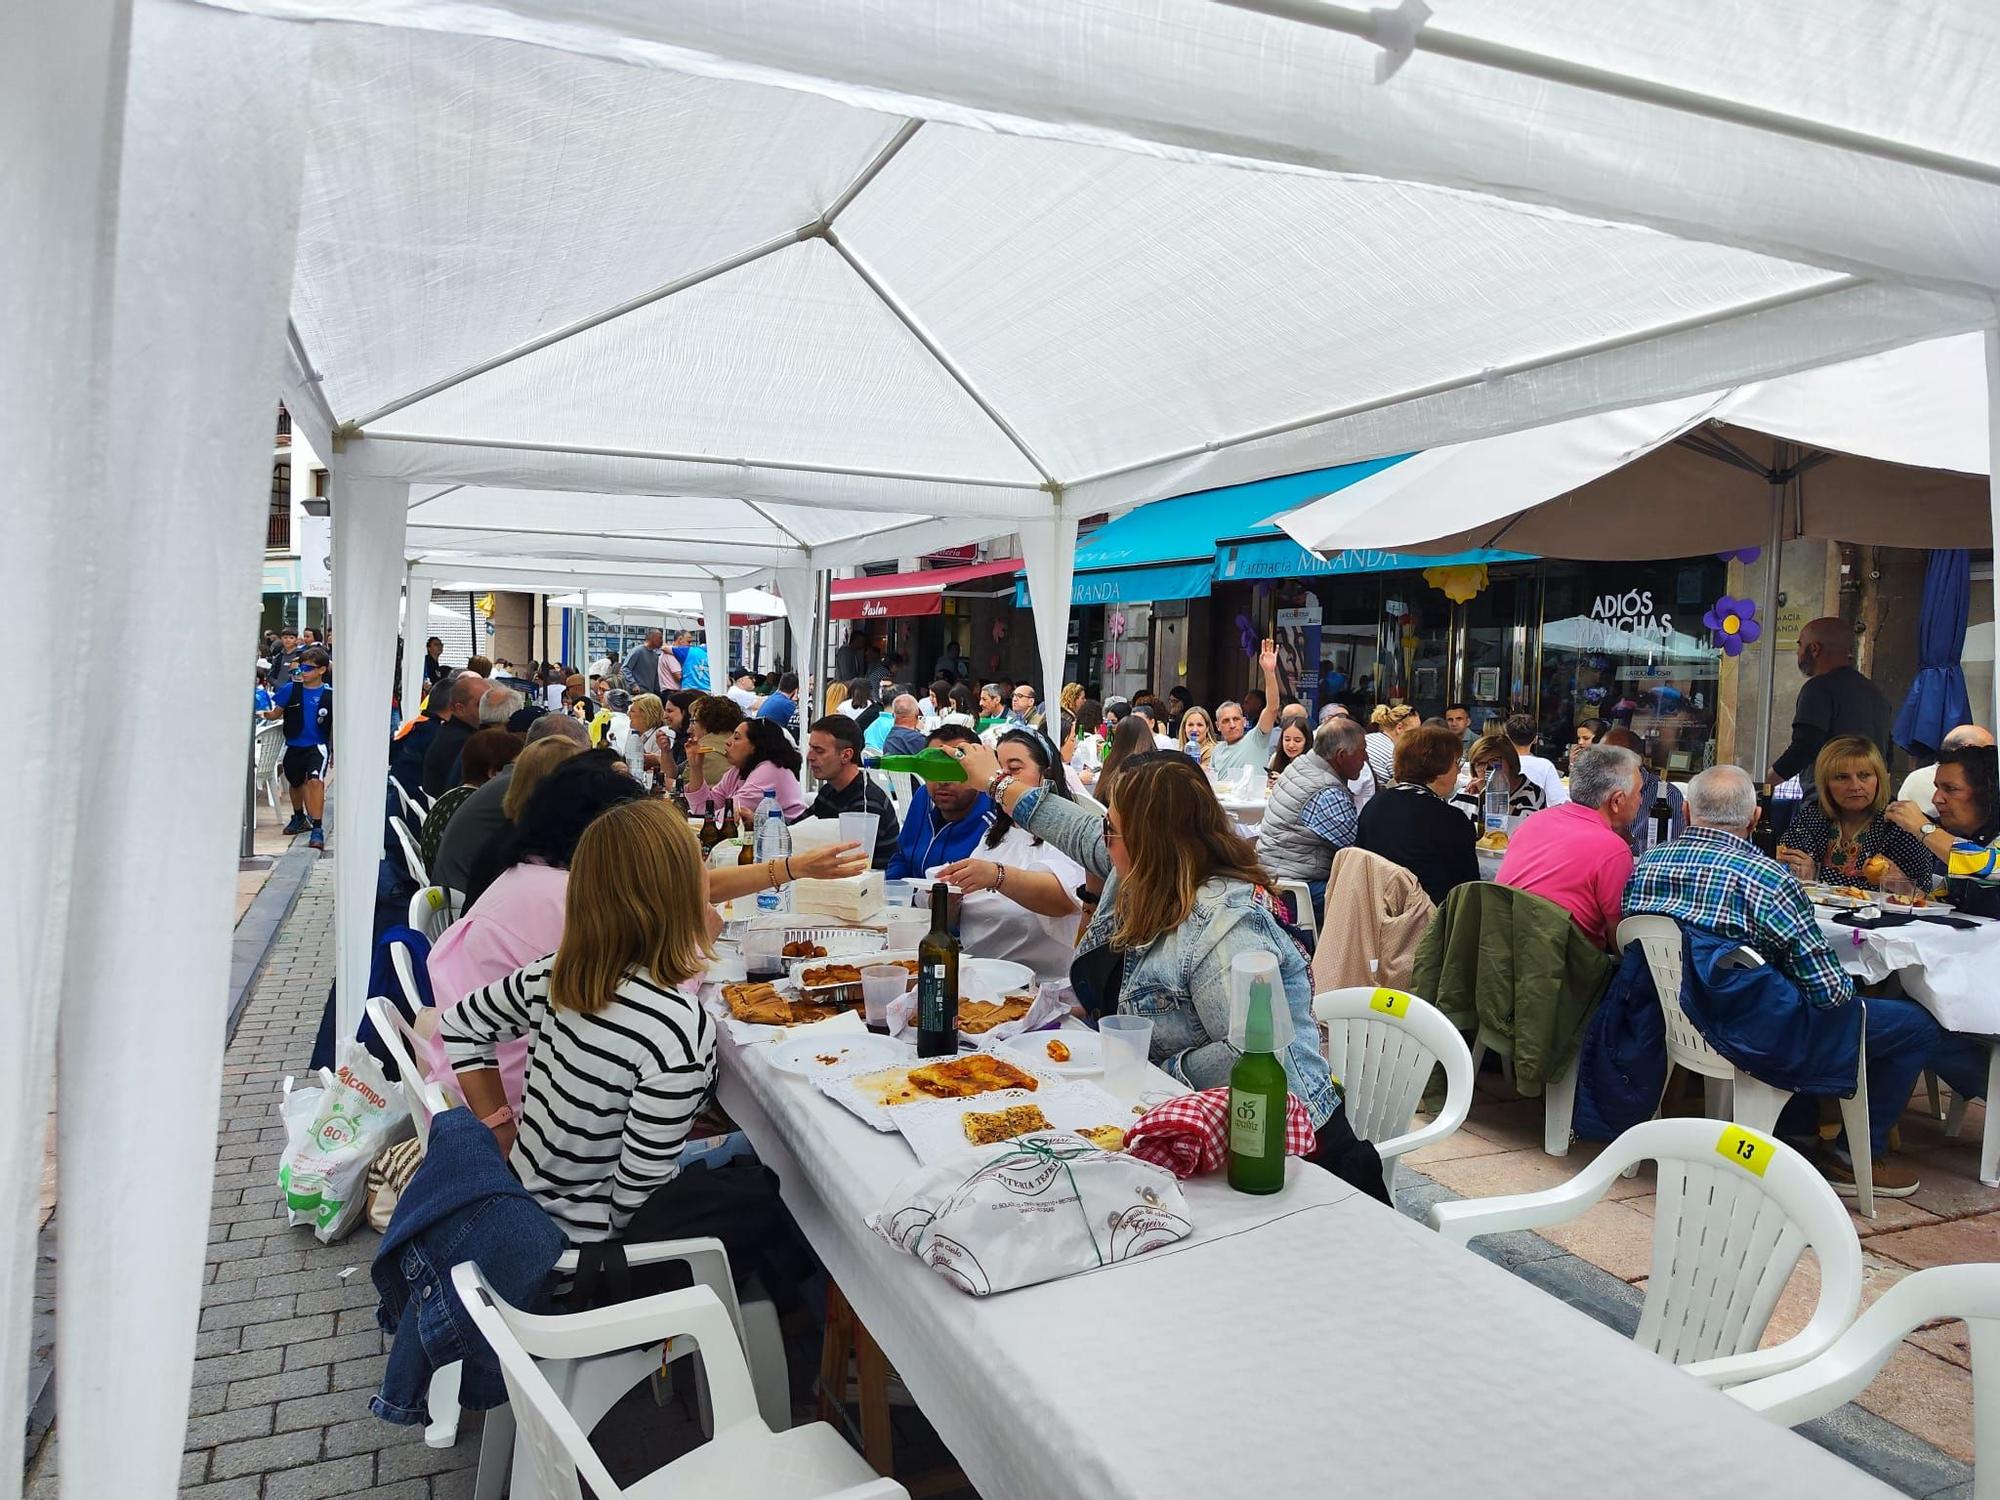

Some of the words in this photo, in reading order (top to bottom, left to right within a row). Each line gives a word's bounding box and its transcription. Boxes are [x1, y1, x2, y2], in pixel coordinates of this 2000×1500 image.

[1590, 588, 1653, 619] ADIÓS
[1386, 996, 1394, 1008] 3
[1736, 1140, 1755, 1160] 13
